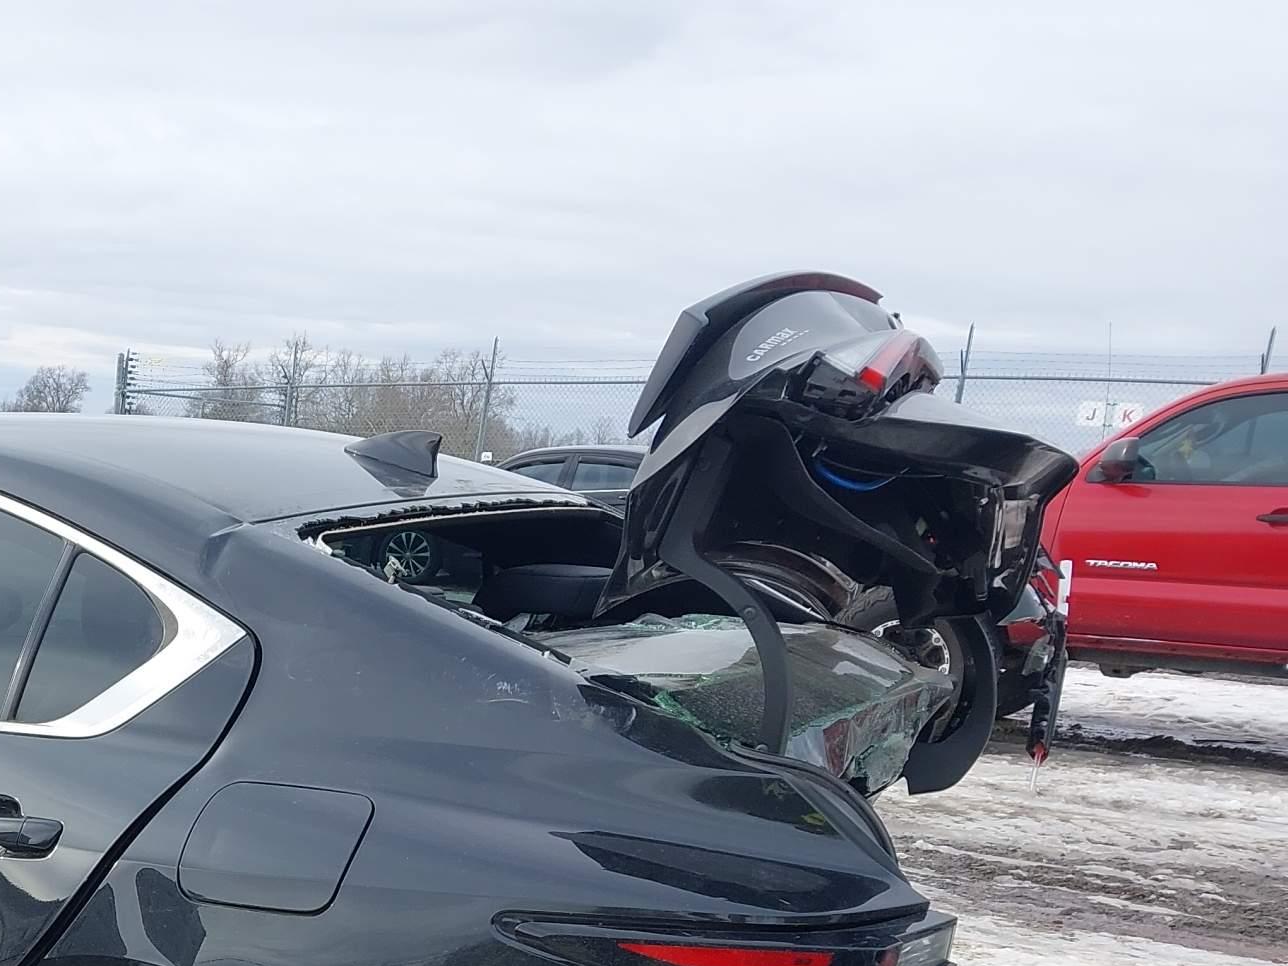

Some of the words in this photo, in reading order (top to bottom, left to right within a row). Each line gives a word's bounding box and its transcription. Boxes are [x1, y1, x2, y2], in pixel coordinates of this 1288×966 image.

[1086, 408, 1097, 420] J
[1122, 410, 1135, 422] K
[1085, 559, 1158, 570] TACOMA
